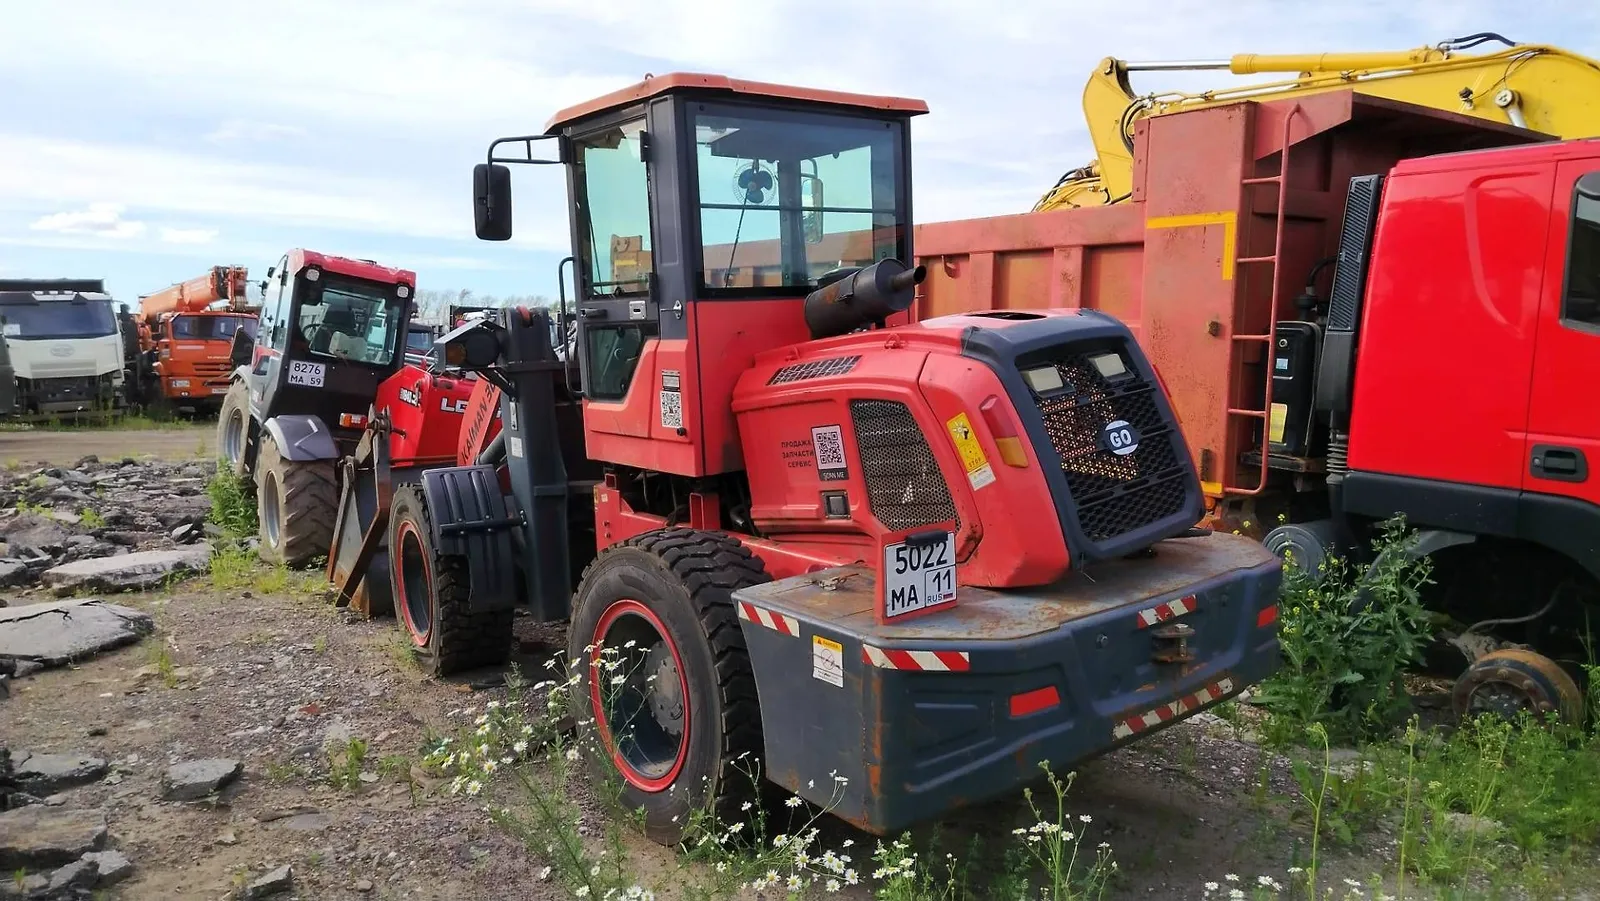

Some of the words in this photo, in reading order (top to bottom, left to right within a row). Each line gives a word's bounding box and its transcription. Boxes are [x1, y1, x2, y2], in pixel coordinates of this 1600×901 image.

[294, 362, 321, 375] 8276
[310, 377, 322, 385] 59
[461, 396, 487, 465] KAIMAN
[781, 440, 812, 448] ПРОДАЖА
[1110, 429, 1132, 448] GO
[782, 450, 815, 459] ЗАПЧАСТИ
[788, 460, 812, 468] СЕРВИС
[895, 541, 948, 575] 5022
[932, 569, 951, 593] 11
[927, 593, 943, 603] RUS
